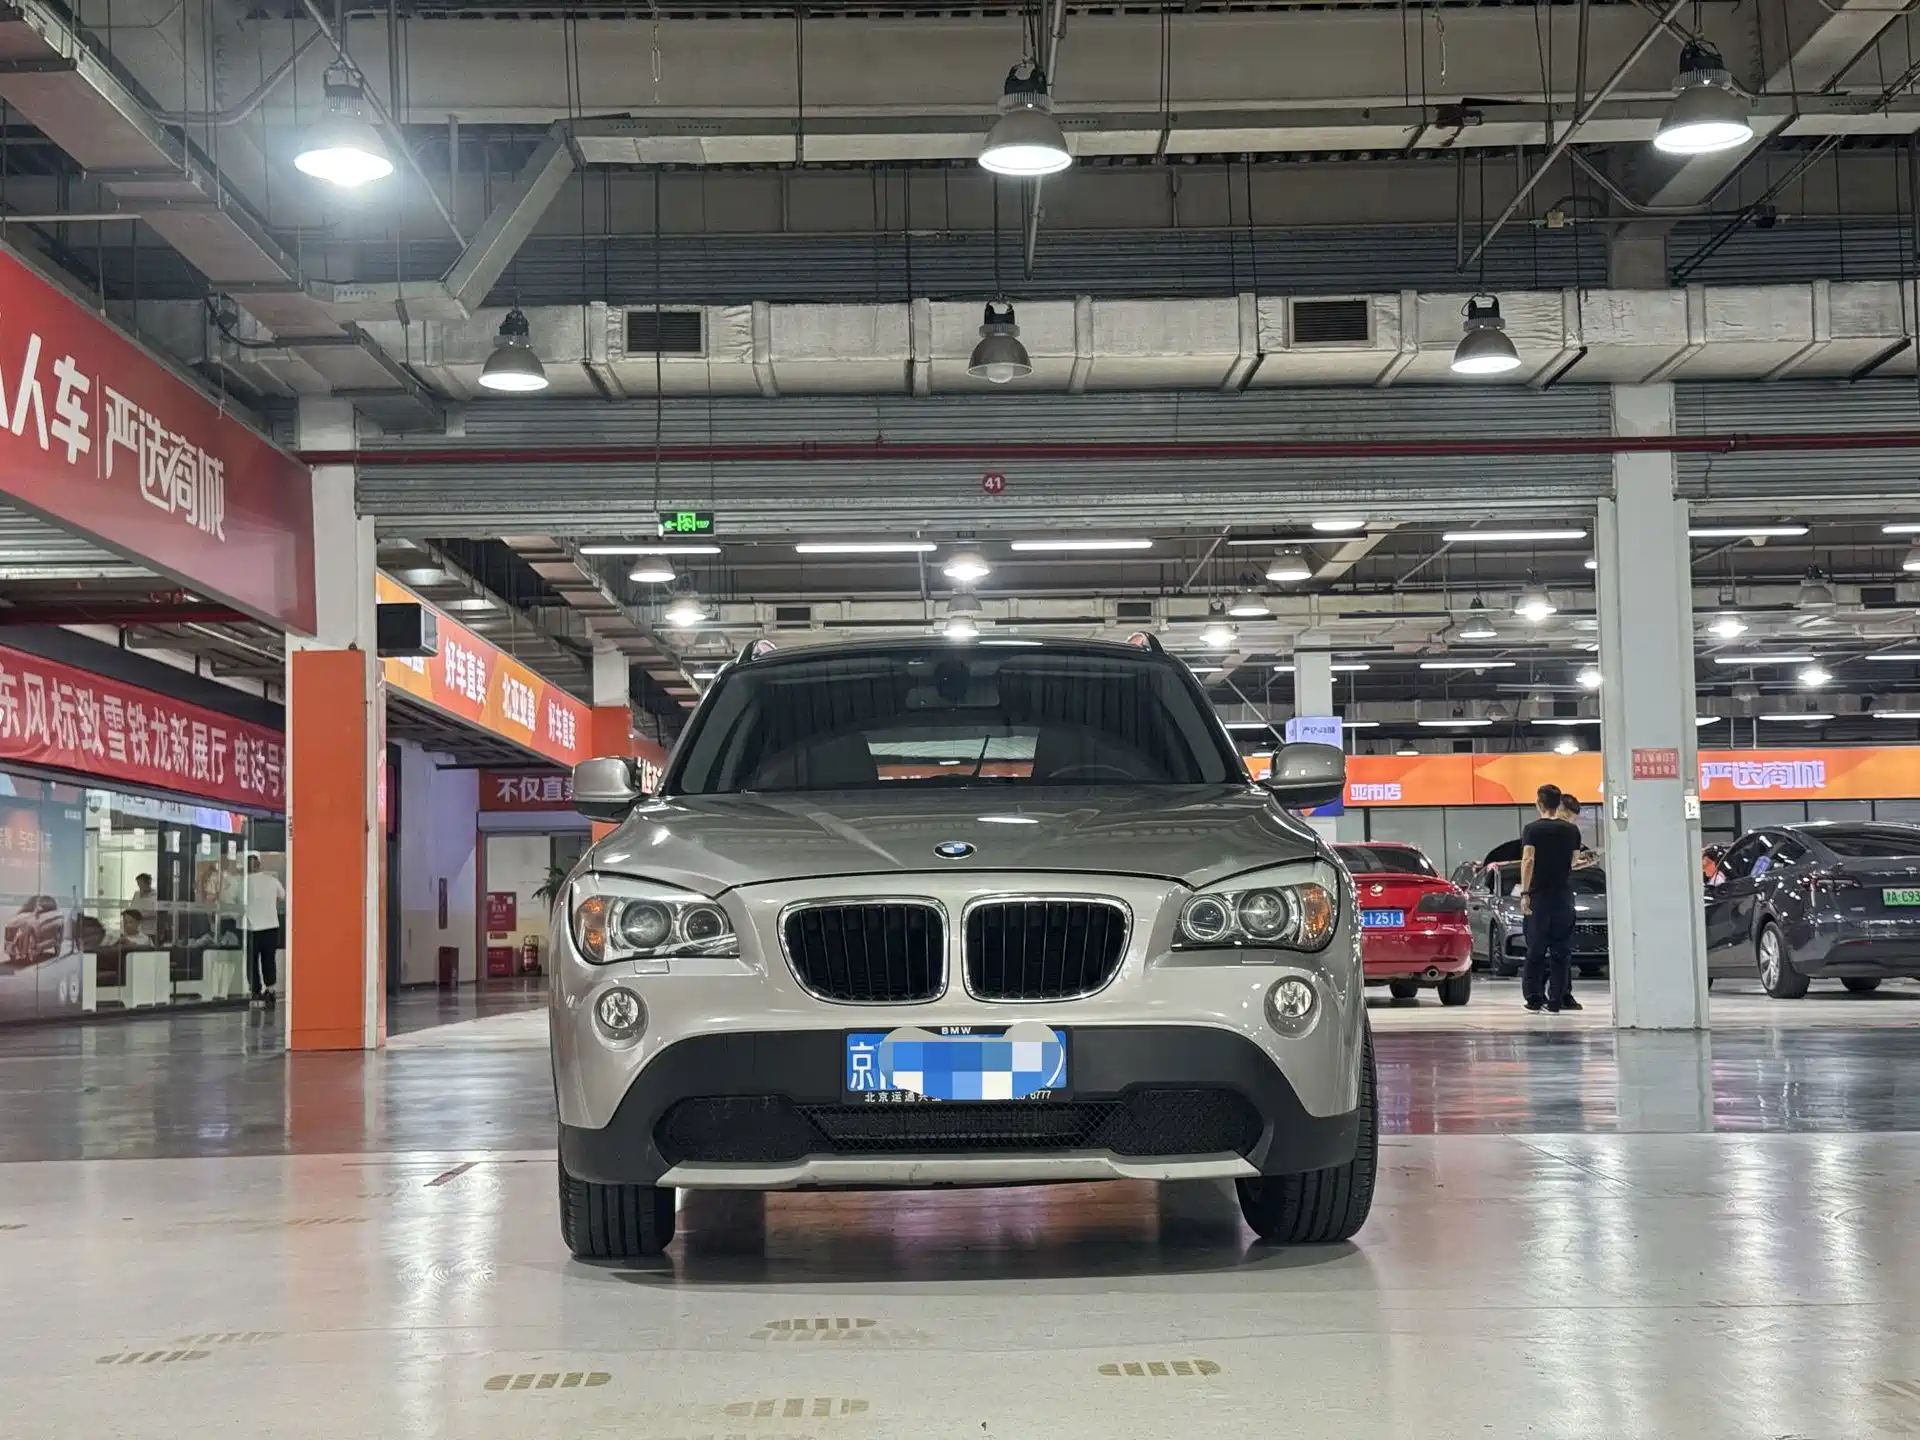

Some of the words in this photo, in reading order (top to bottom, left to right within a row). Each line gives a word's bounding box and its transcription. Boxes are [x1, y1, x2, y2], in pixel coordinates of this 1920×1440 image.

[0, 332, 91, 465] 人车
[985, 477, 1001, 489] 41
[941, 1026, 972, 1035] BMW
